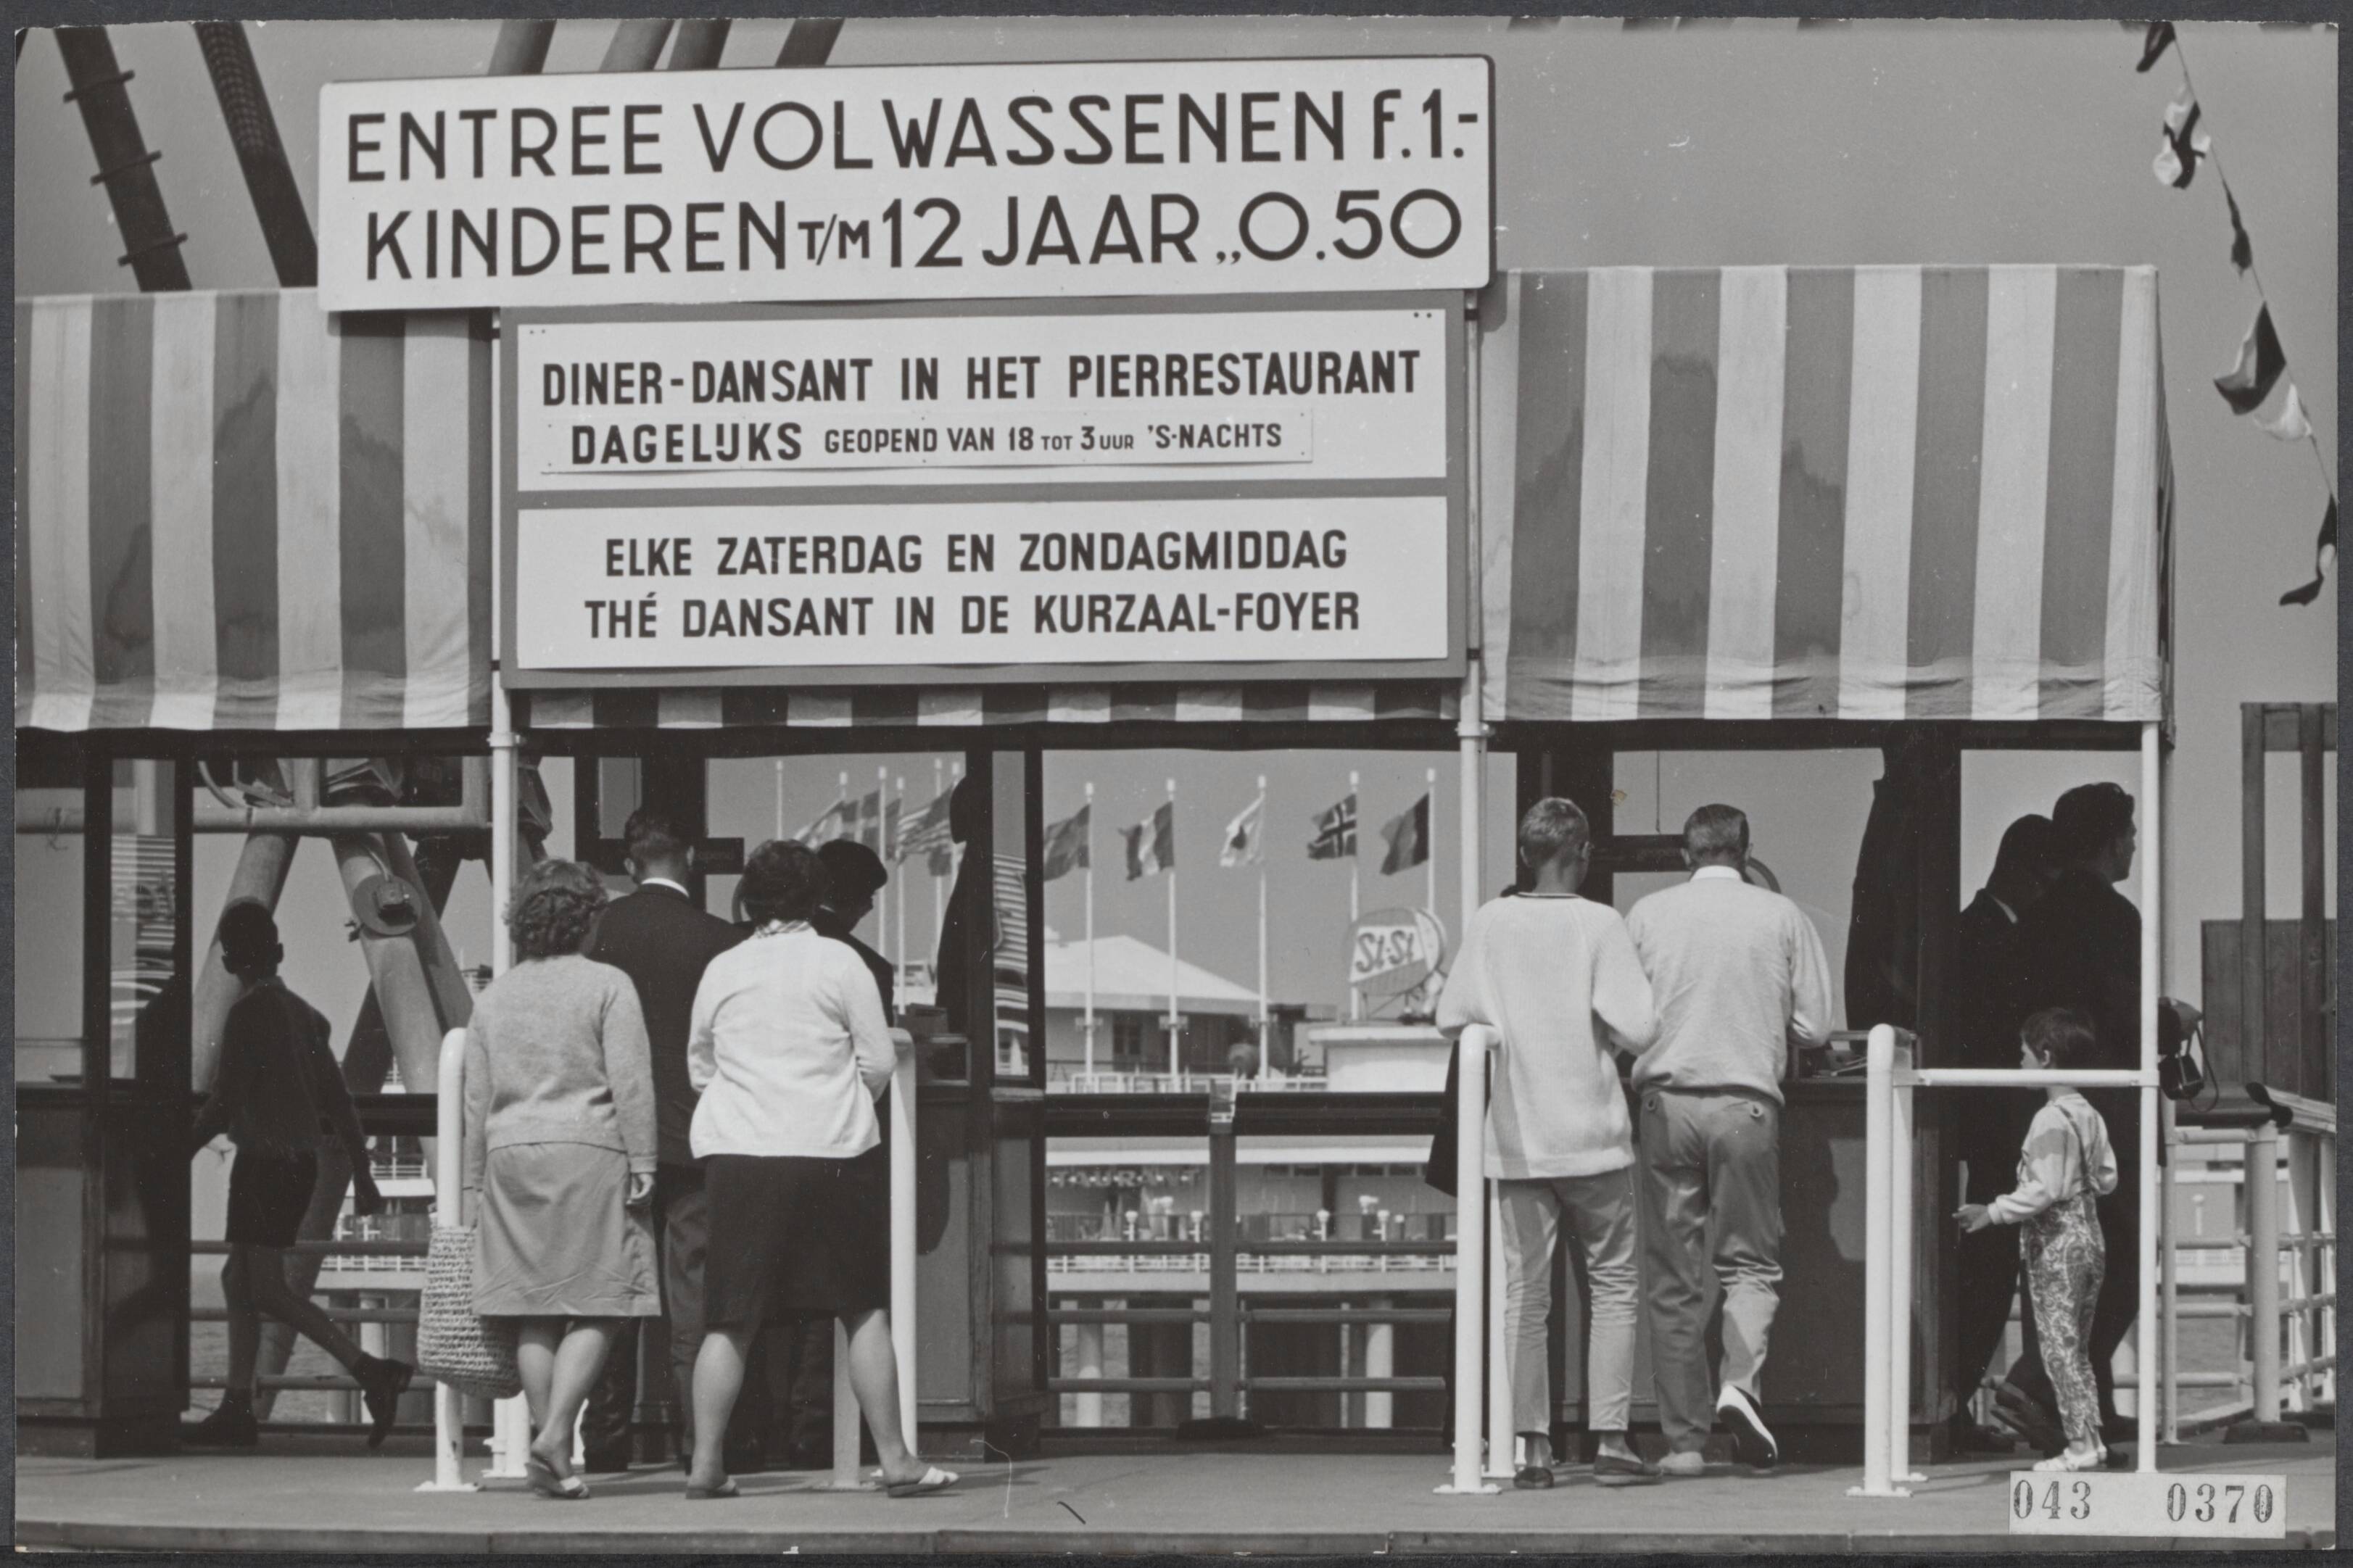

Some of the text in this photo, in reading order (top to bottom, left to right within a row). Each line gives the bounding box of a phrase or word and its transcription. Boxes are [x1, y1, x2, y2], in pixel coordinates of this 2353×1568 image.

[349, 105, 662, 182] ENTREE
[693, 91, 1344, 172] VOLWASSENEN
[368, 201, 785, 280] KINDEREN
[798, 214, 869, 265] T/M
[882, 198, 962, 267] 12
[983, 194, 1199, 266] JAAR
[543, 350, 1420, 406] DINER-DANSANT IN HET PIERRESTAURANT
[572, 422, 801, 465] DAGELIJKS
[825, 428, 938, 453] GEOPEND
[947, 427, 994, 452] VAN
[1009, 426, 1033, 451] 18
[1041, 436, 1072, 450] TOT
[1080, 426, 1095, 450] 3
[1100, 435, 1133, 449] UUR
[606, 529, 1347, 576] ELKE ZATERDAG EN ZONDAGMIDDAG
[584, 592, 1359, 638] THÉ DANSANT IN DE KURZAAL-FOYER
